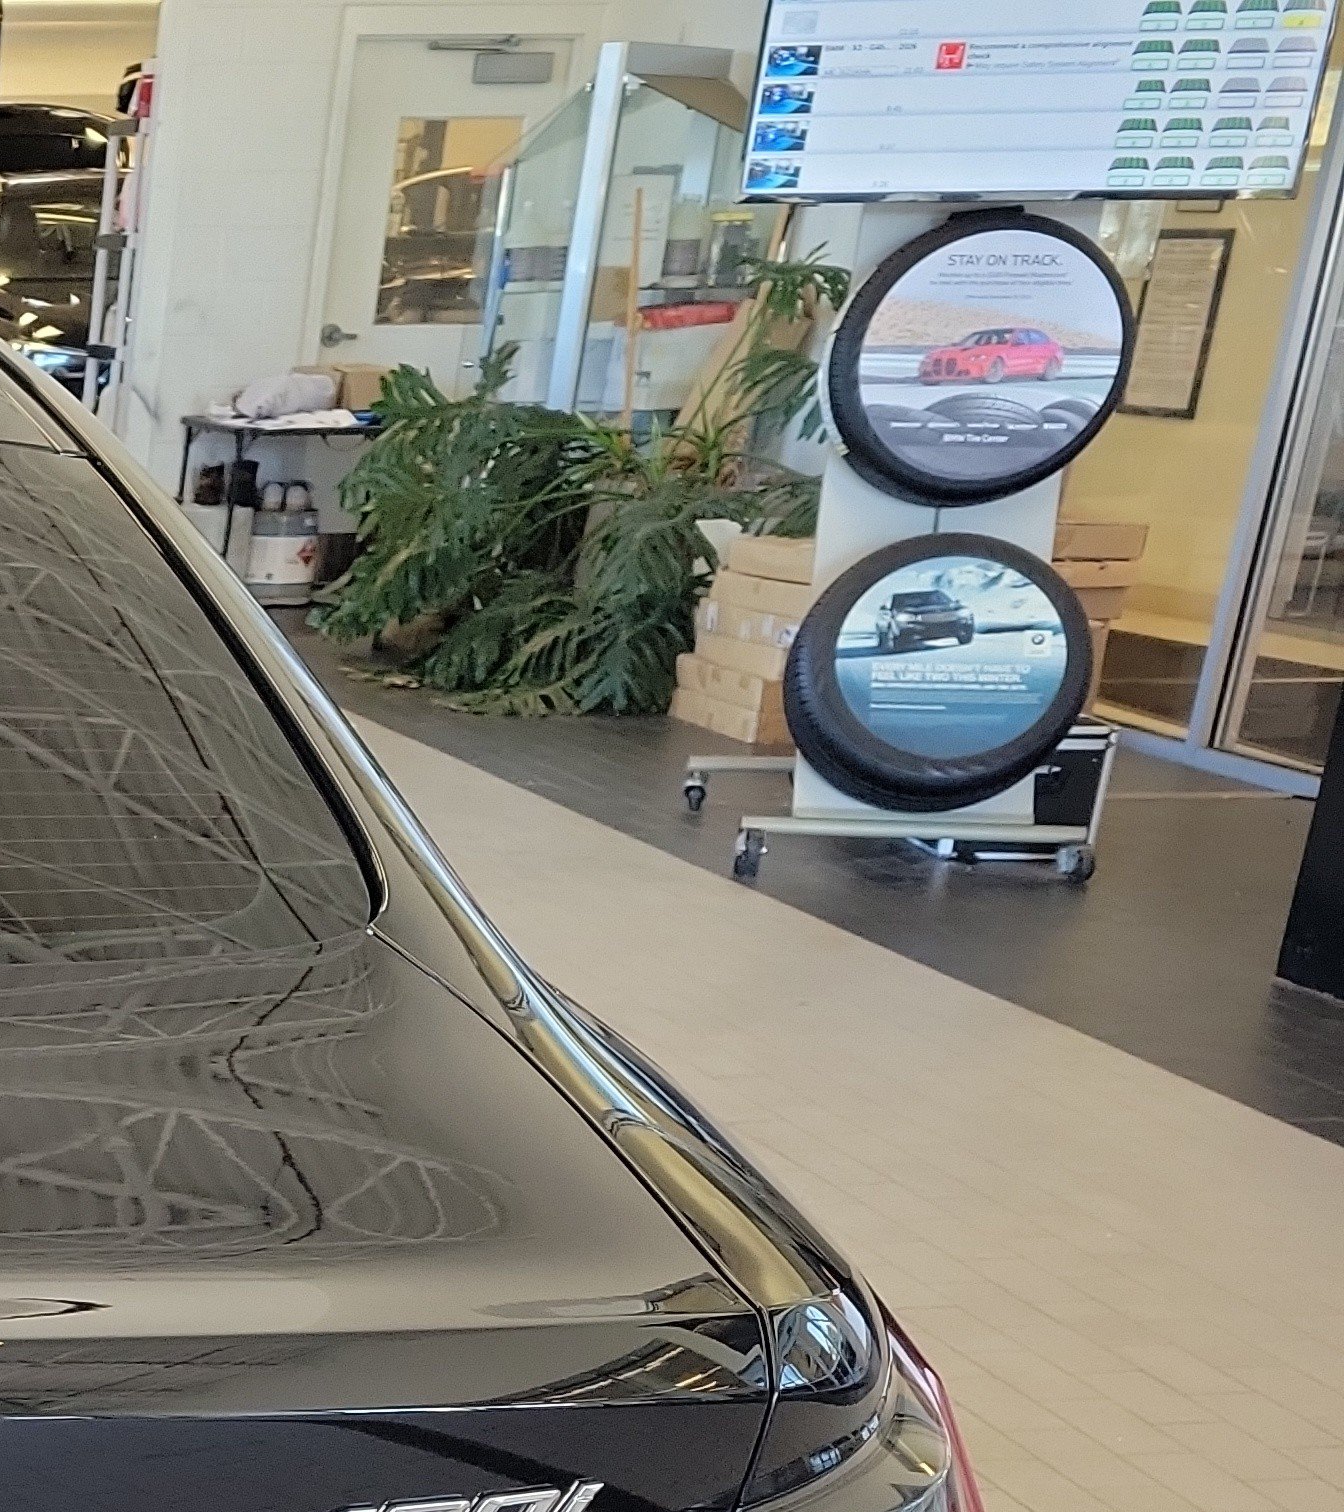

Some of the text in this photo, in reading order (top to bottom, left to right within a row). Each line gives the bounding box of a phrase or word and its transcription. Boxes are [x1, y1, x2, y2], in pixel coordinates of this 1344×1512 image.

[947, 254, 1063, 266] STAY ON TRACK.
